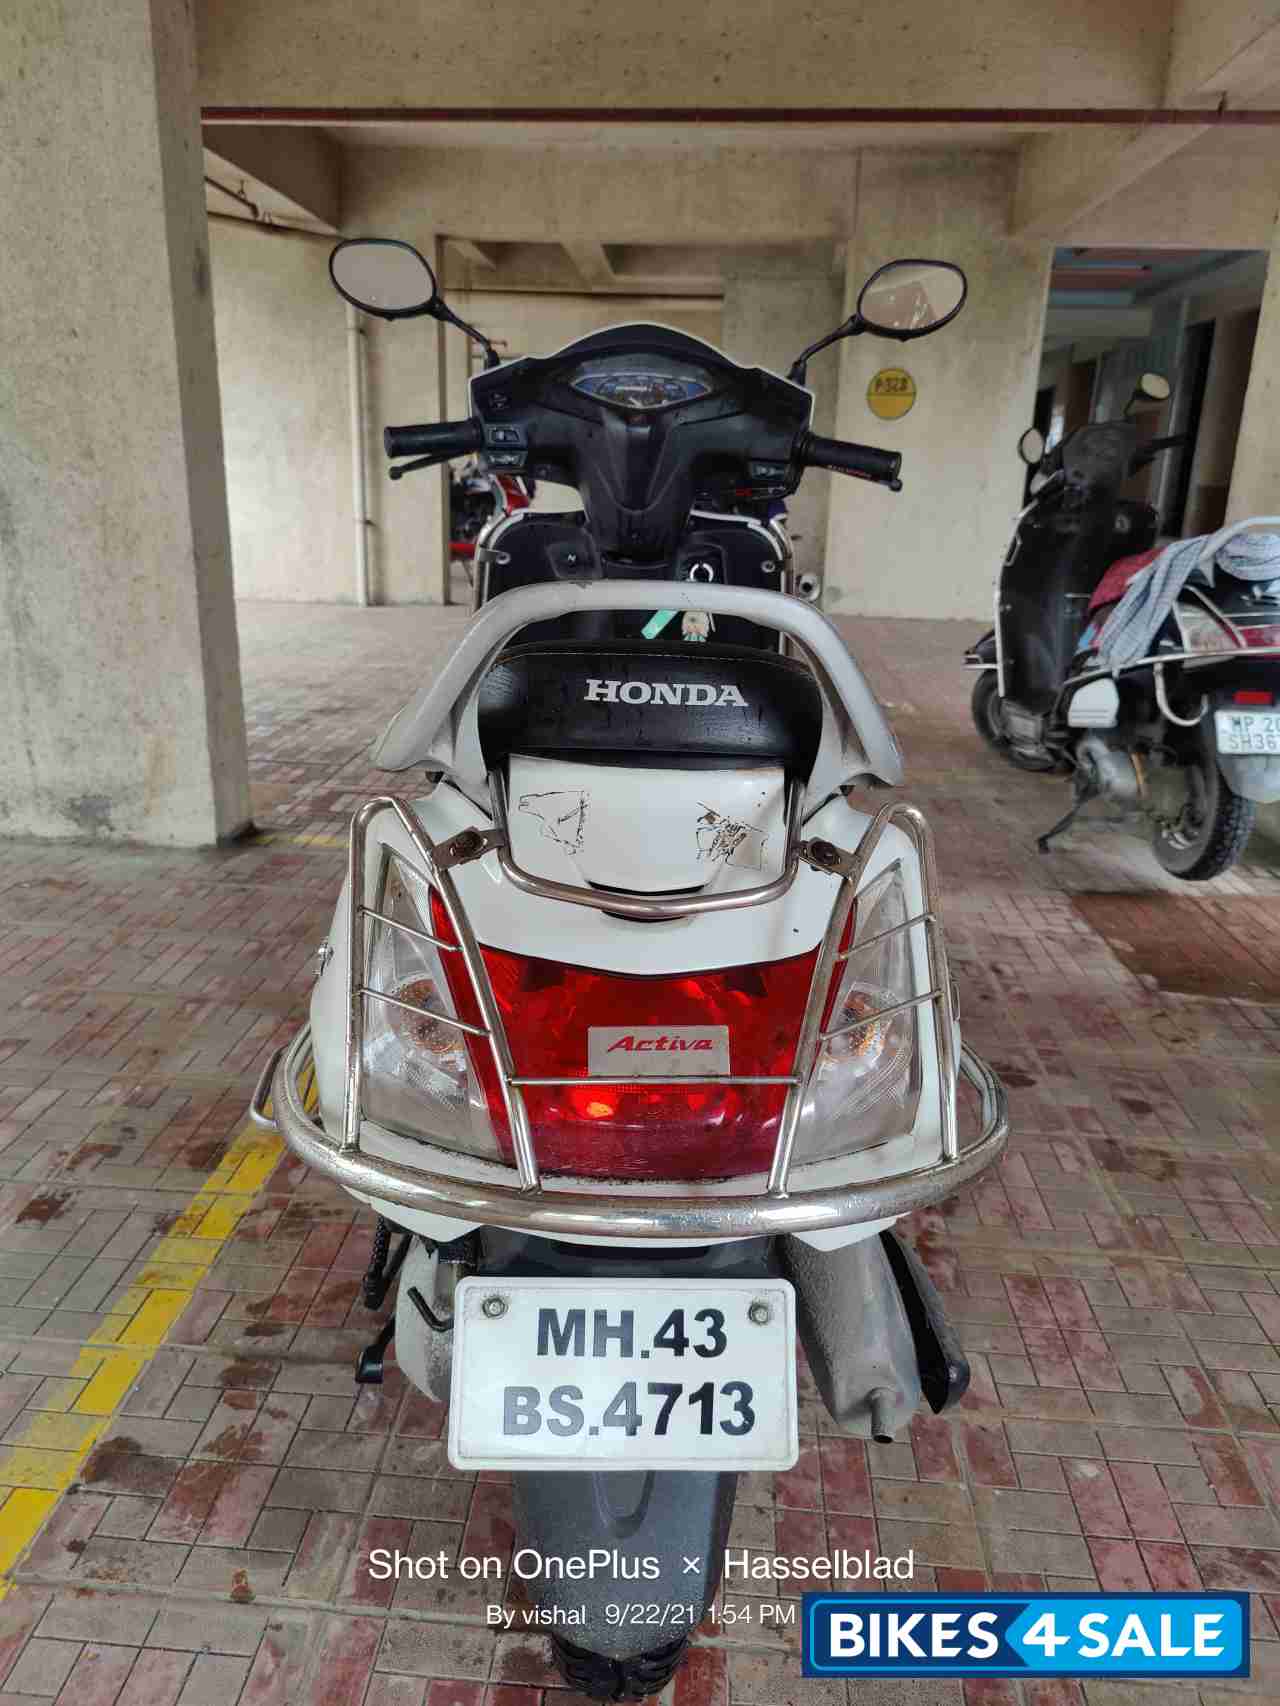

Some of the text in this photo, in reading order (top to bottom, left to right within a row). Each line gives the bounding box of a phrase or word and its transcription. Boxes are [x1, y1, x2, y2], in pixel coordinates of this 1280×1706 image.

[583, 679, 749, 707] HONDA
[606, 1035, 713, 1053] Activa
[537, 1308, 727, 1358] MH.43
[503, 1381, 755, 1436] BS.4713
